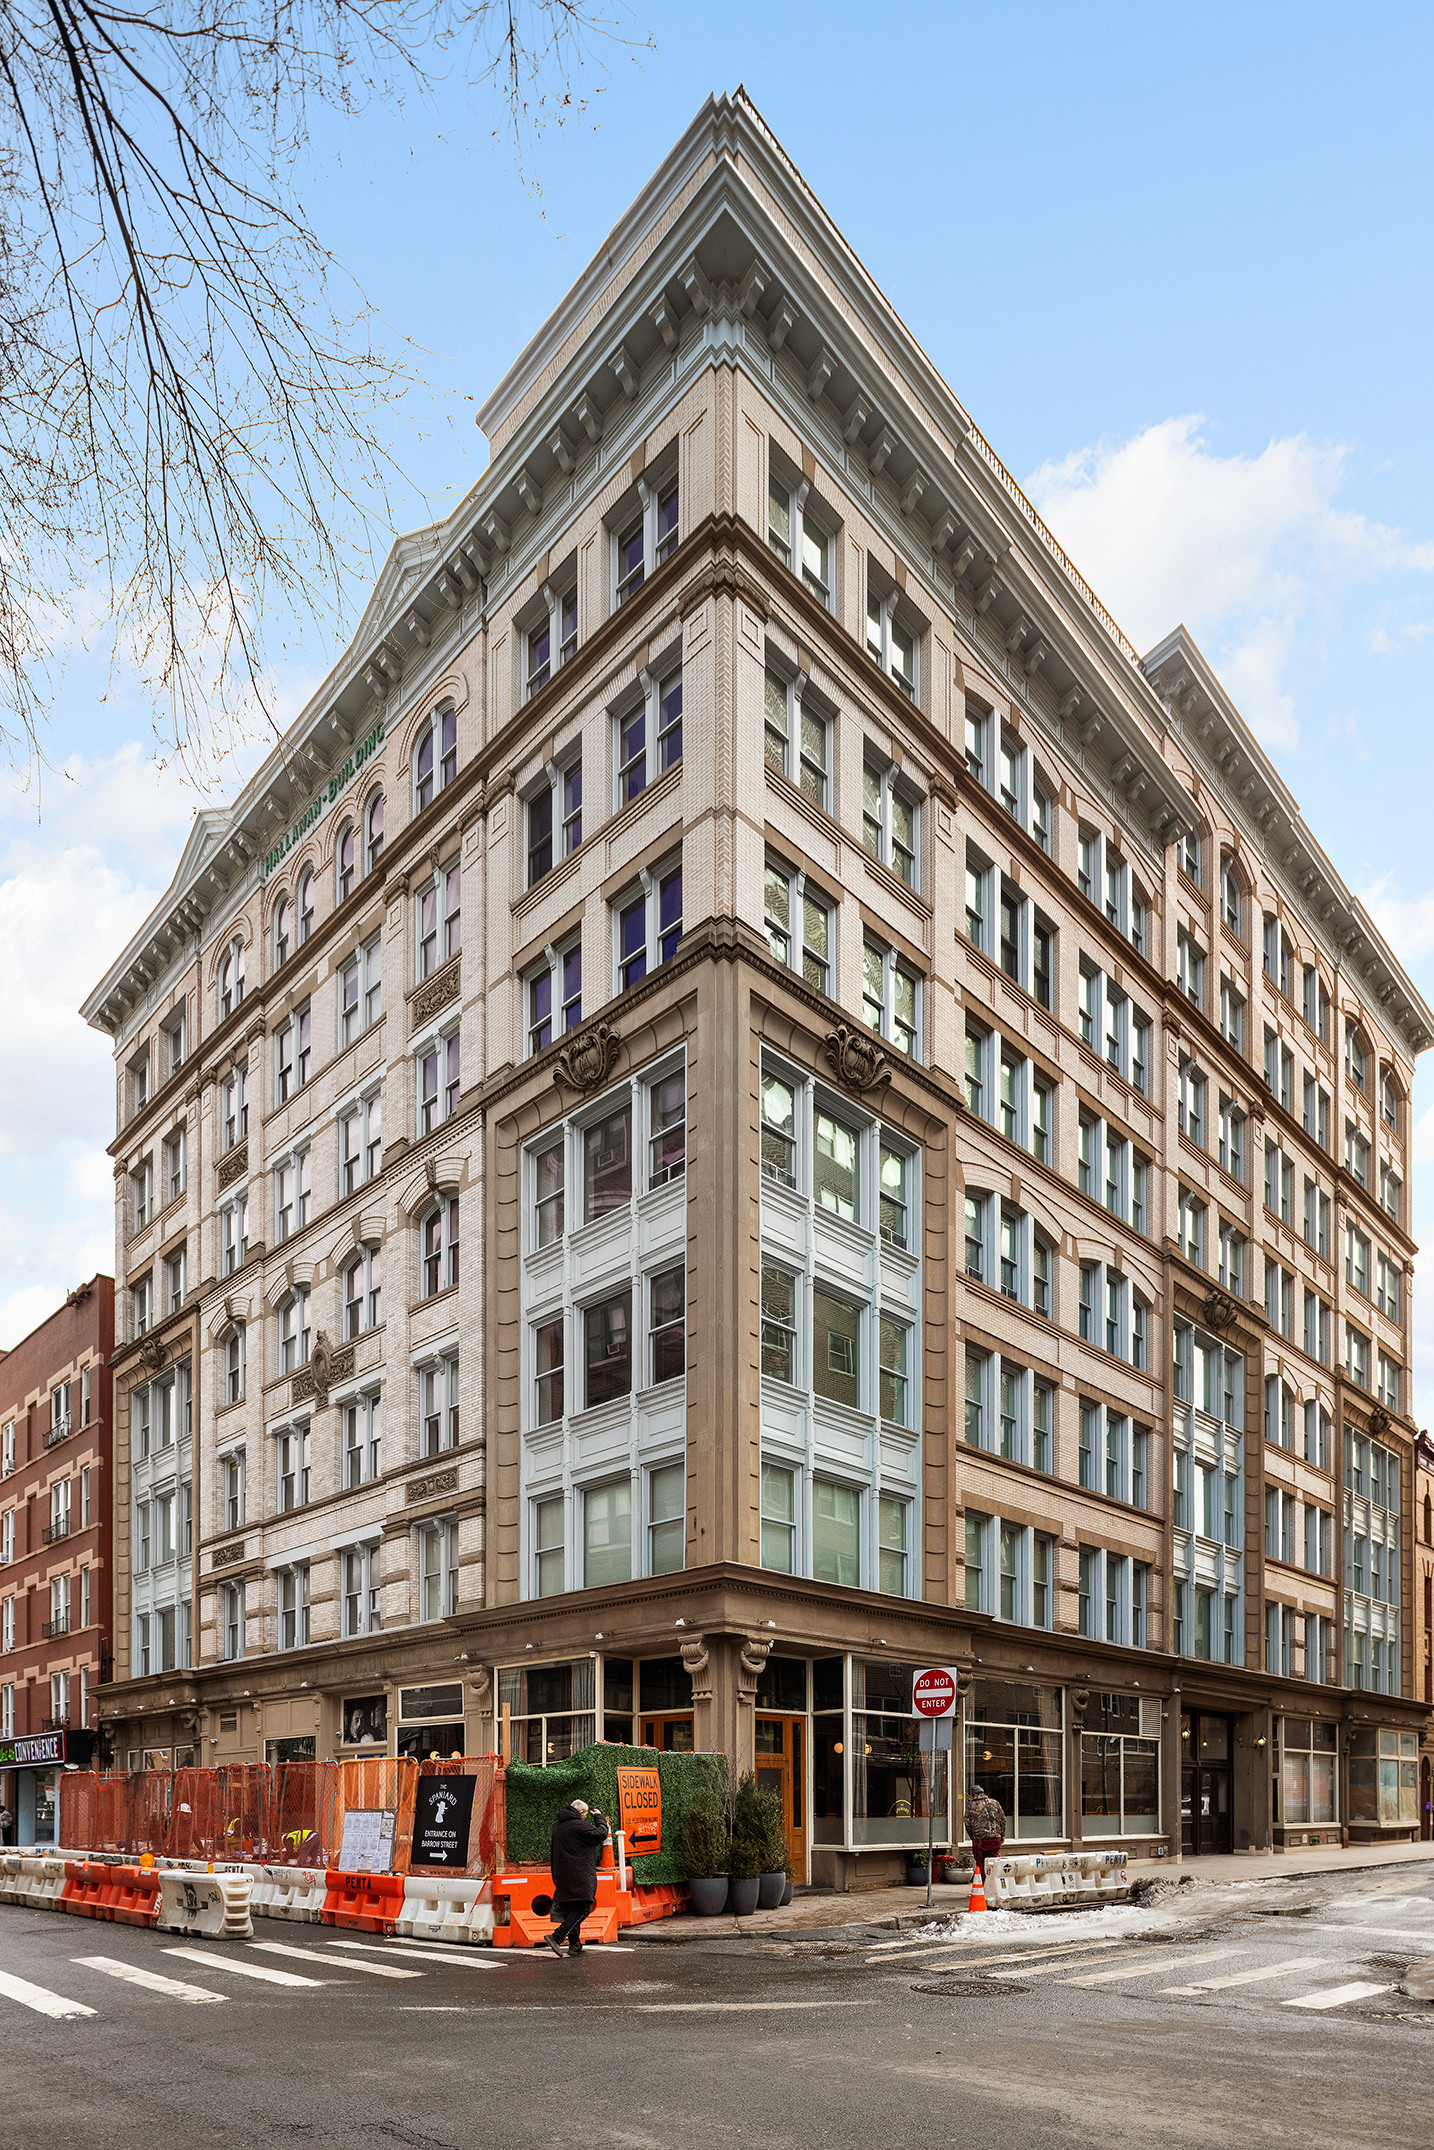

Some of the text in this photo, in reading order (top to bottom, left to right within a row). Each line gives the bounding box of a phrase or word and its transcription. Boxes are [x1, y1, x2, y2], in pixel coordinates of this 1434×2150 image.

[919, 1677, 950, 1688] DO NOT
[921, 1699, 946, 1709] ENTER
[14, 1737, 59, 1762] CONVENIENCE
[621, 1775, 658, 1789] SIDEWALK
[428, 1790, 458, 1806] SPANIARD
[624, 1791, 659, 1809] CLOSED
[424, 1829, 457, 1838] ENTRANCE ON
[421, 1840, 458, 1849] BARROW STREET
[1105, 1854, 1127, 1865] PENTA
[345, 1876, 372, 1890] PENTA
